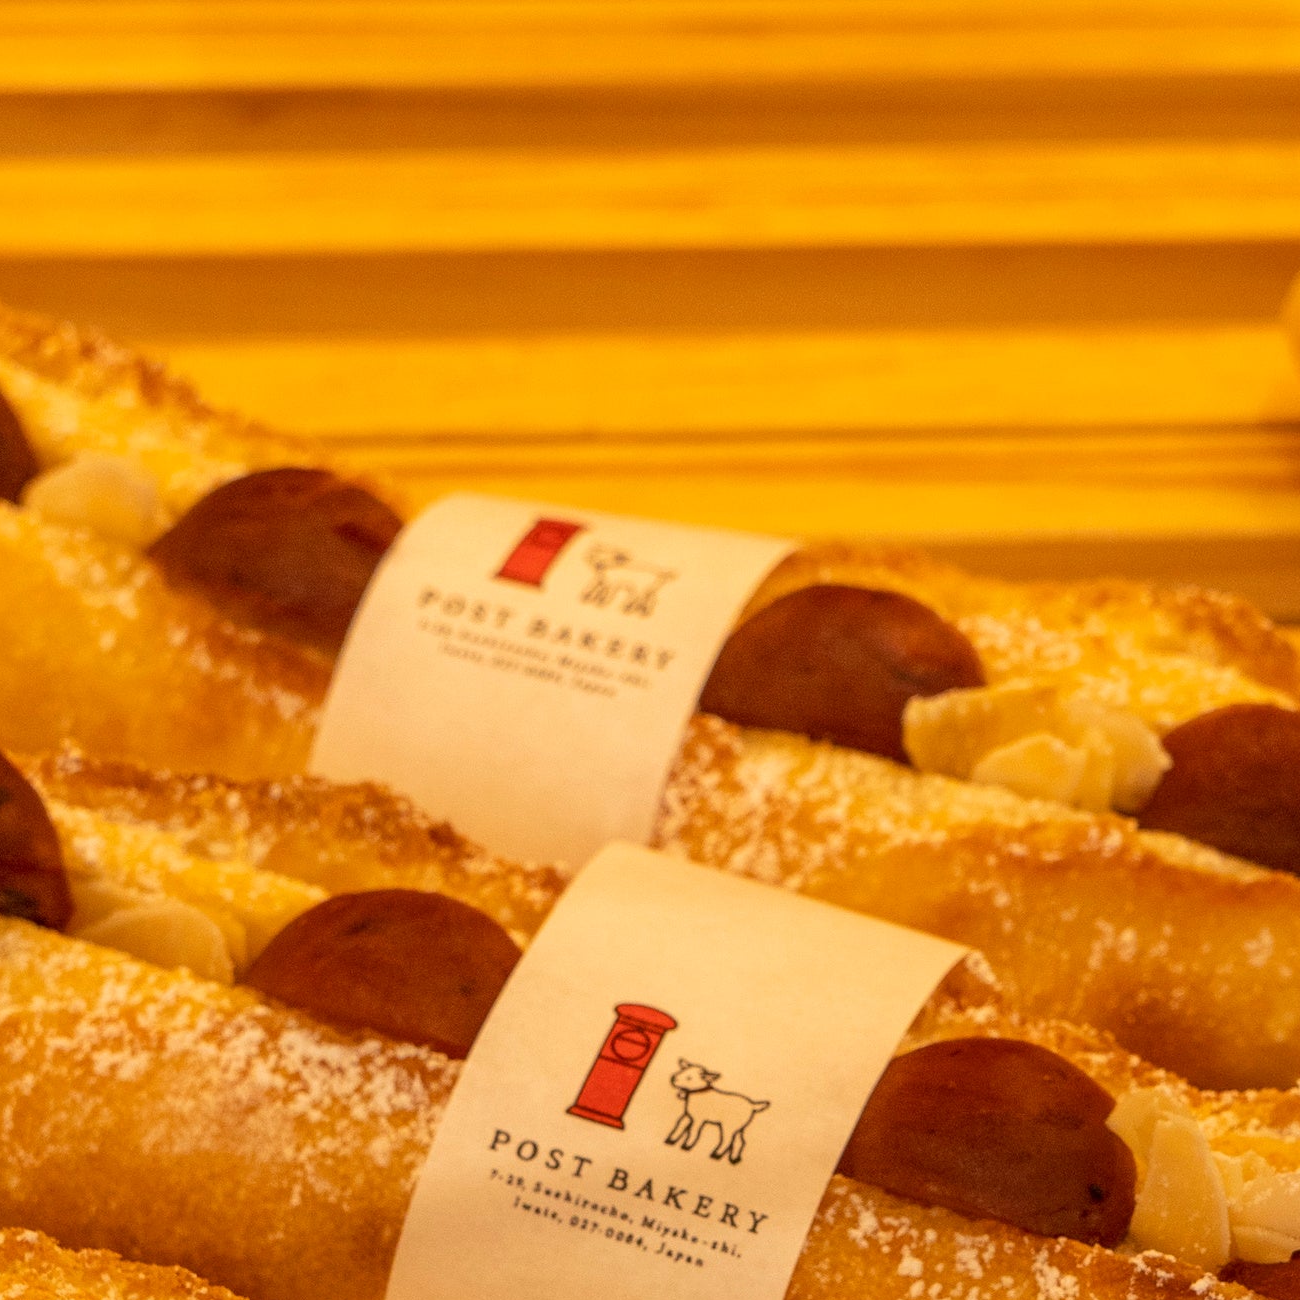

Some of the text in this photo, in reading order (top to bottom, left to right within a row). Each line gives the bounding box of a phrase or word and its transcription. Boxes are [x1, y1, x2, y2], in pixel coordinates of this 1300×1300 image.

[489, 1129, 768, 1233] POST BAKERY
[655, 1242, 704, 1267] Japan
